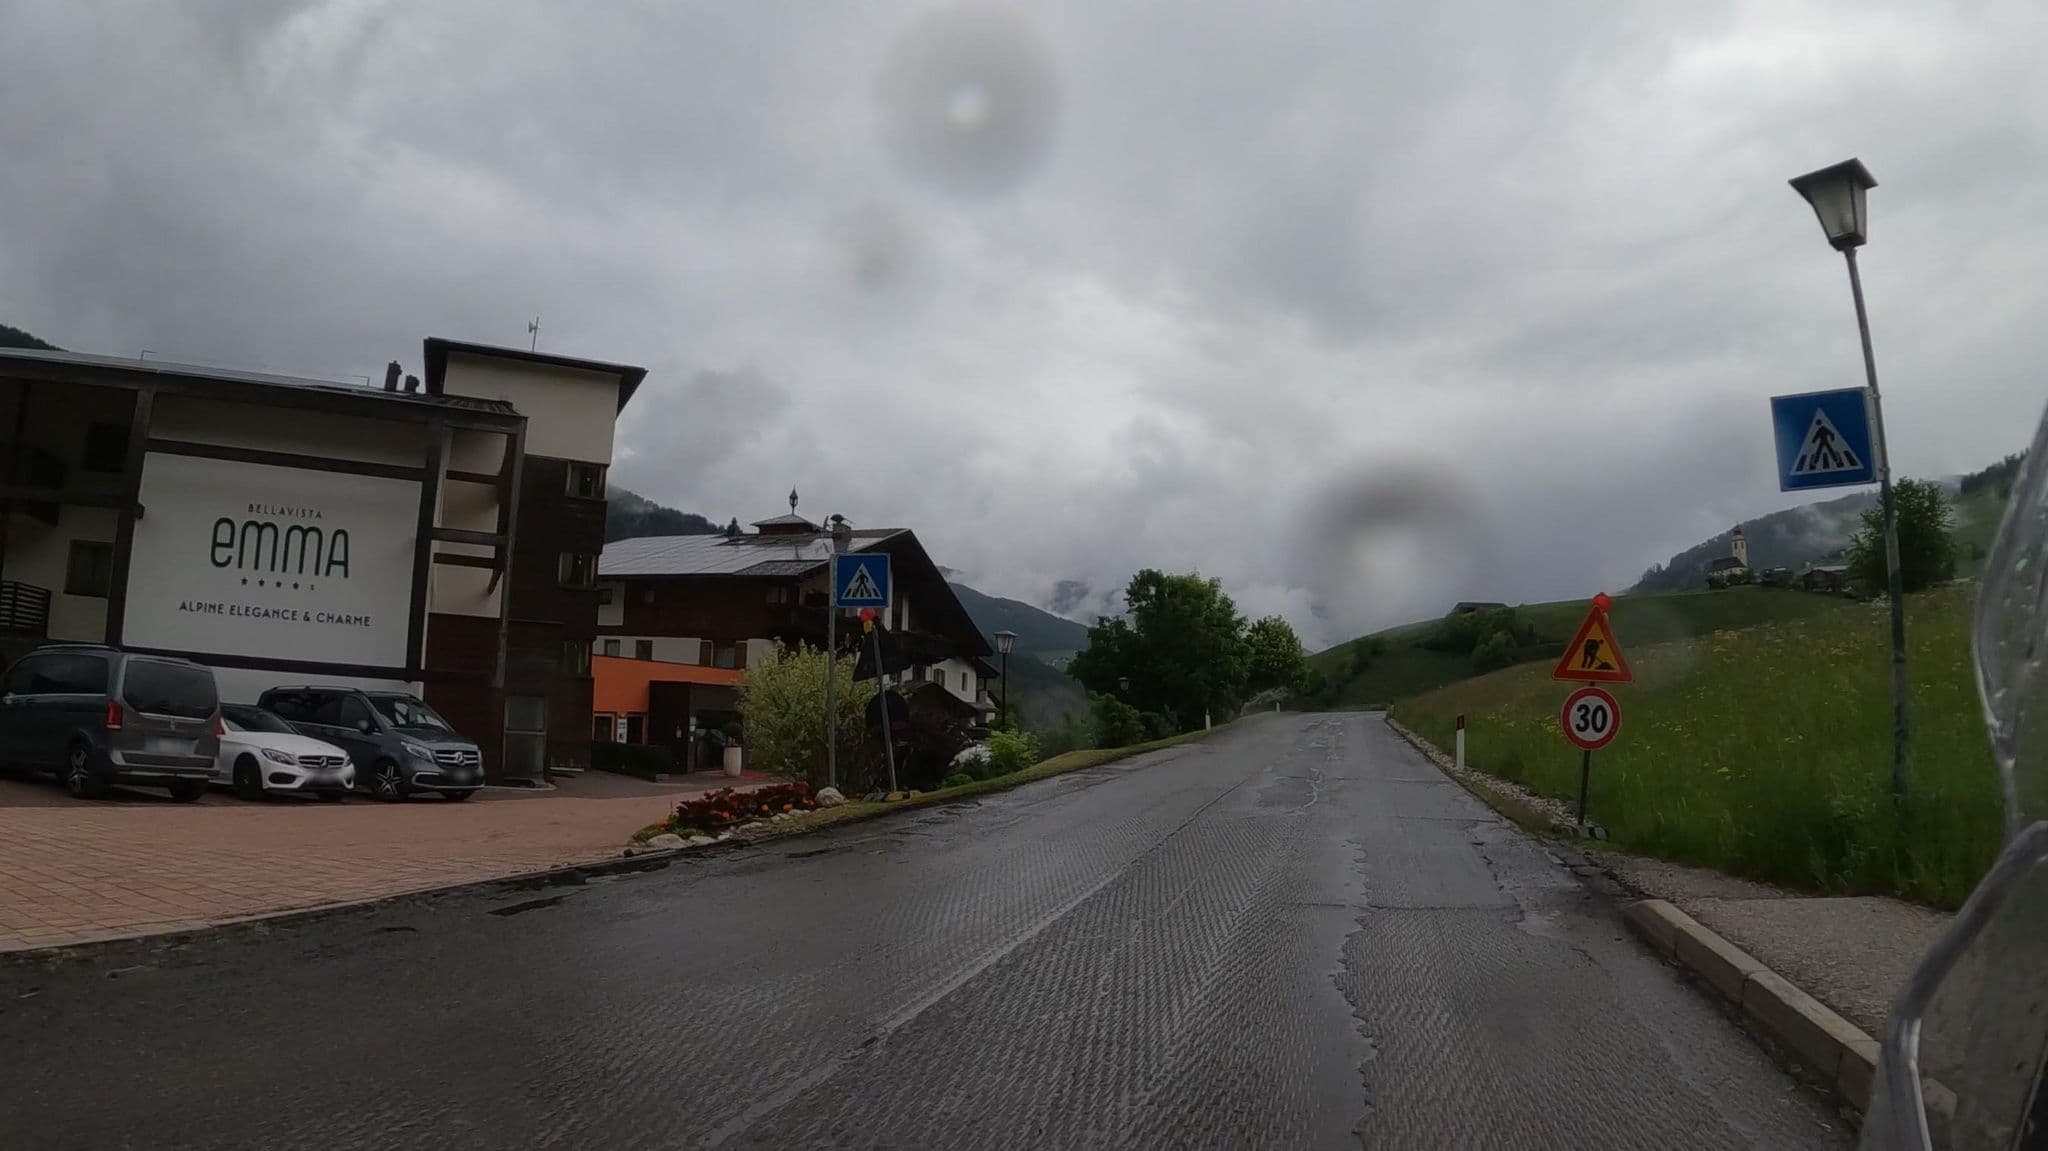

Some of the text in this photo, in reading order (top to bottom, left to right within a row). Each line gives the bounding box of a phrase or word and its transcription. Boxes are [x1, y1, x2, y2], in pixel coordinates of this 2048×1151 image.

[248, 503, 323, 518] BELLAVISTA
[179, 600, 371, 627] ALPINE ELEGANCE & CHARME
[1575, 704, 1608, 733] 30
